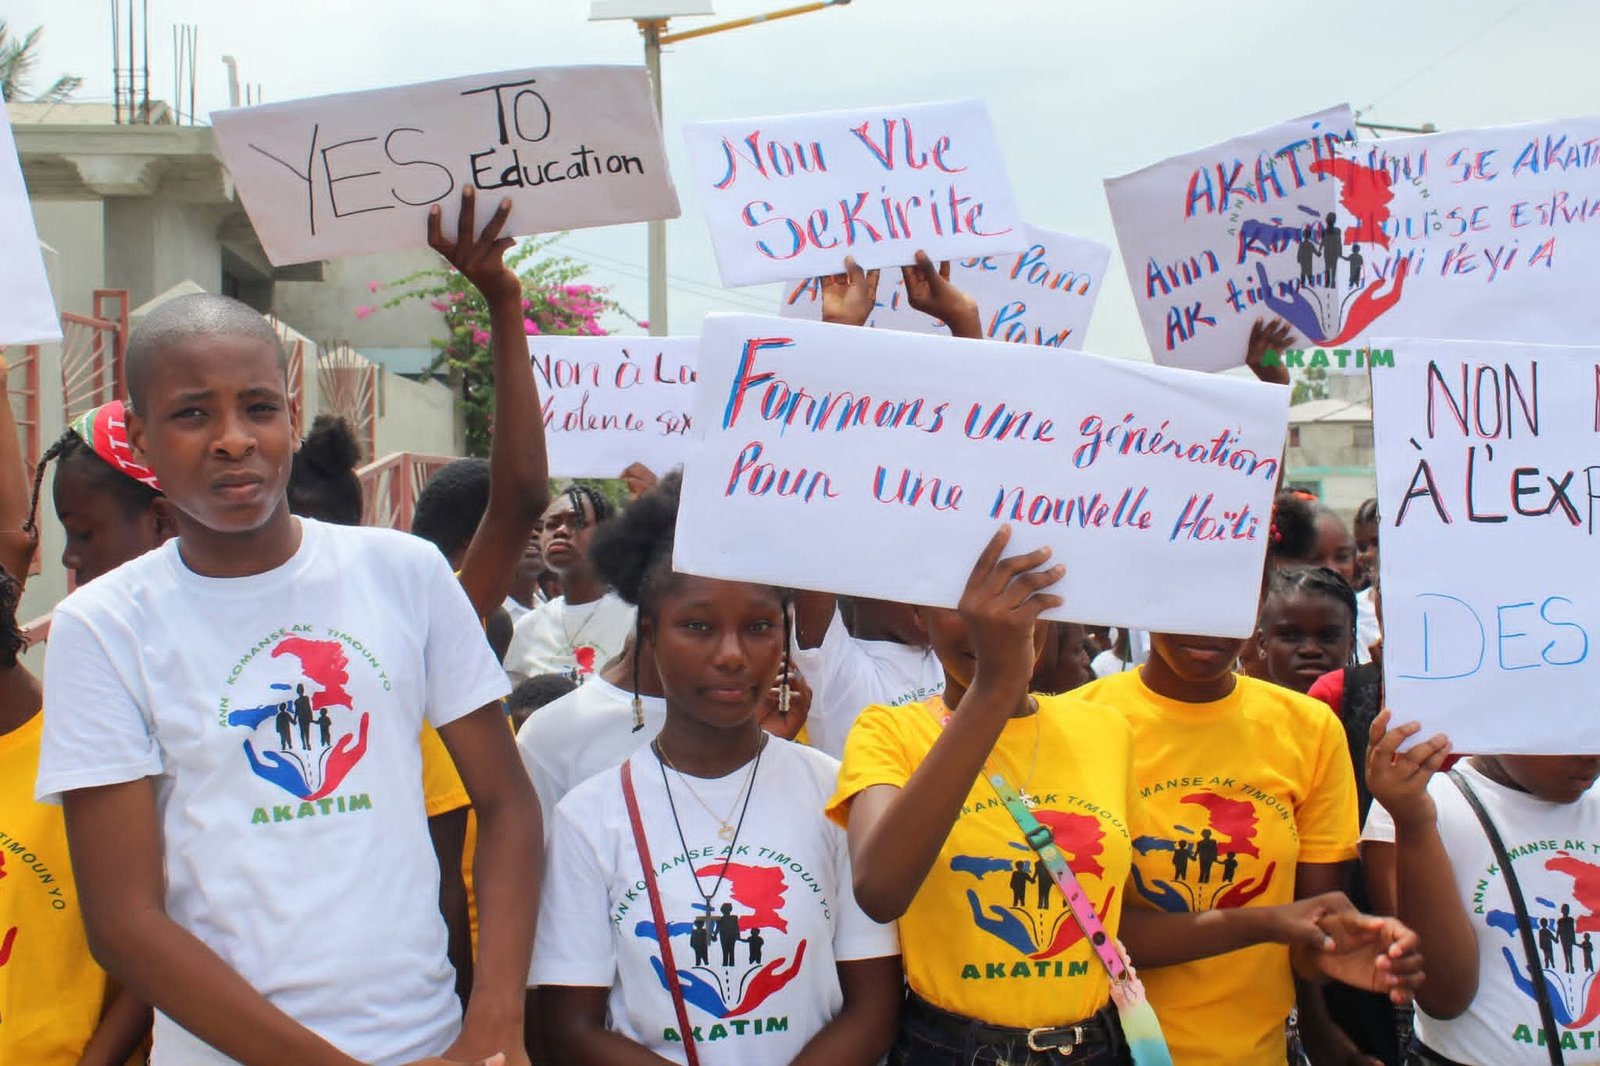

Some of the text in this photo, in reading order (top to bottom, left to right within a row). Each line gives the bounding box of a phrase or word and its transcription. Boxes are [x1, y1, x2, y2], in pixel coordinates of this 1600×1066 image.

[249, 79, 551, 235] YES TO
[470, 144, 644, 190] Education
[713, 130, 827, 189] Nou
[1447, 147, 1499, 183] SE
[1445, 204, 1491, 237] SE
[531, 354, 600, 389] Non
[722, 338, 949, 437] Formons
[1427, 360, 1539, 439] NON
[1395, 437, 1453, 527] À
[1397, 592, 1589, 680] DES
[218, 624, 392, 727] ANN KOMANSE AK TIMOUN YO
[251, 793, 373, 825] AKATIM
[1032, 793, 1129, 838] AK TIMOUN
[1209, 776, 1237, 788] AK
[1239, 783, 1290, 821] TIMOUN
[0, 832, 66, 910] TIMOUN YO
[614, 902, 629, 925] NN
[721, 845, 750, 856] AK
[759, 847, 821, 893] TIMOUN
[820, 898, 831, 920] YO
[1473, 840, 1586, 914] ANN KMANSE AK
[961, 960, 1089, 980] AKATIM
[663, 1016, 788, 1042] AKATIM
